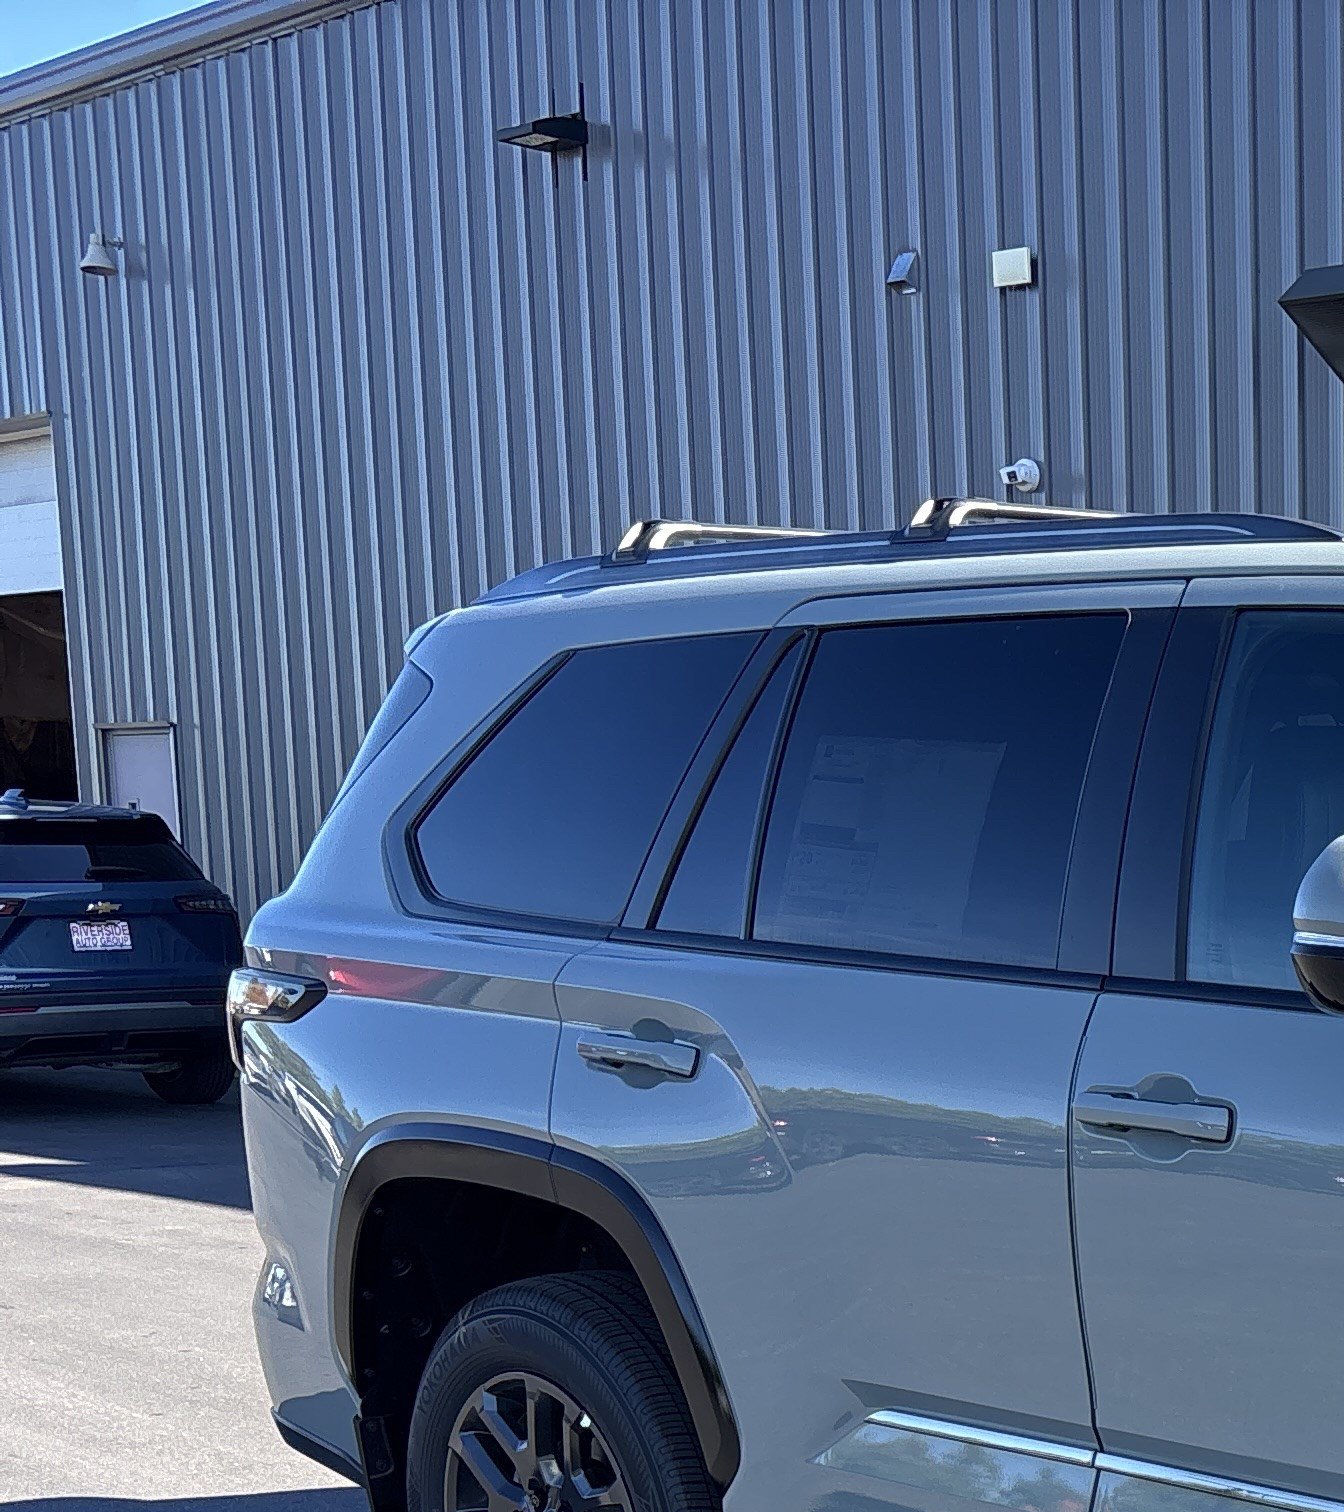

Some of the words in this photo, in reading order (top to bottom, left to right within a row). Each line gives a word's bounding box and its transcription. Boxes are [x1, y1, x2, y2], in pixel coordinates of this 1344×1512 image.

[71, 924, 130, 937] RIVERSIDE
[75, 936, 98, 947] AUTO
[99, 935, 130, 947] GROUP
